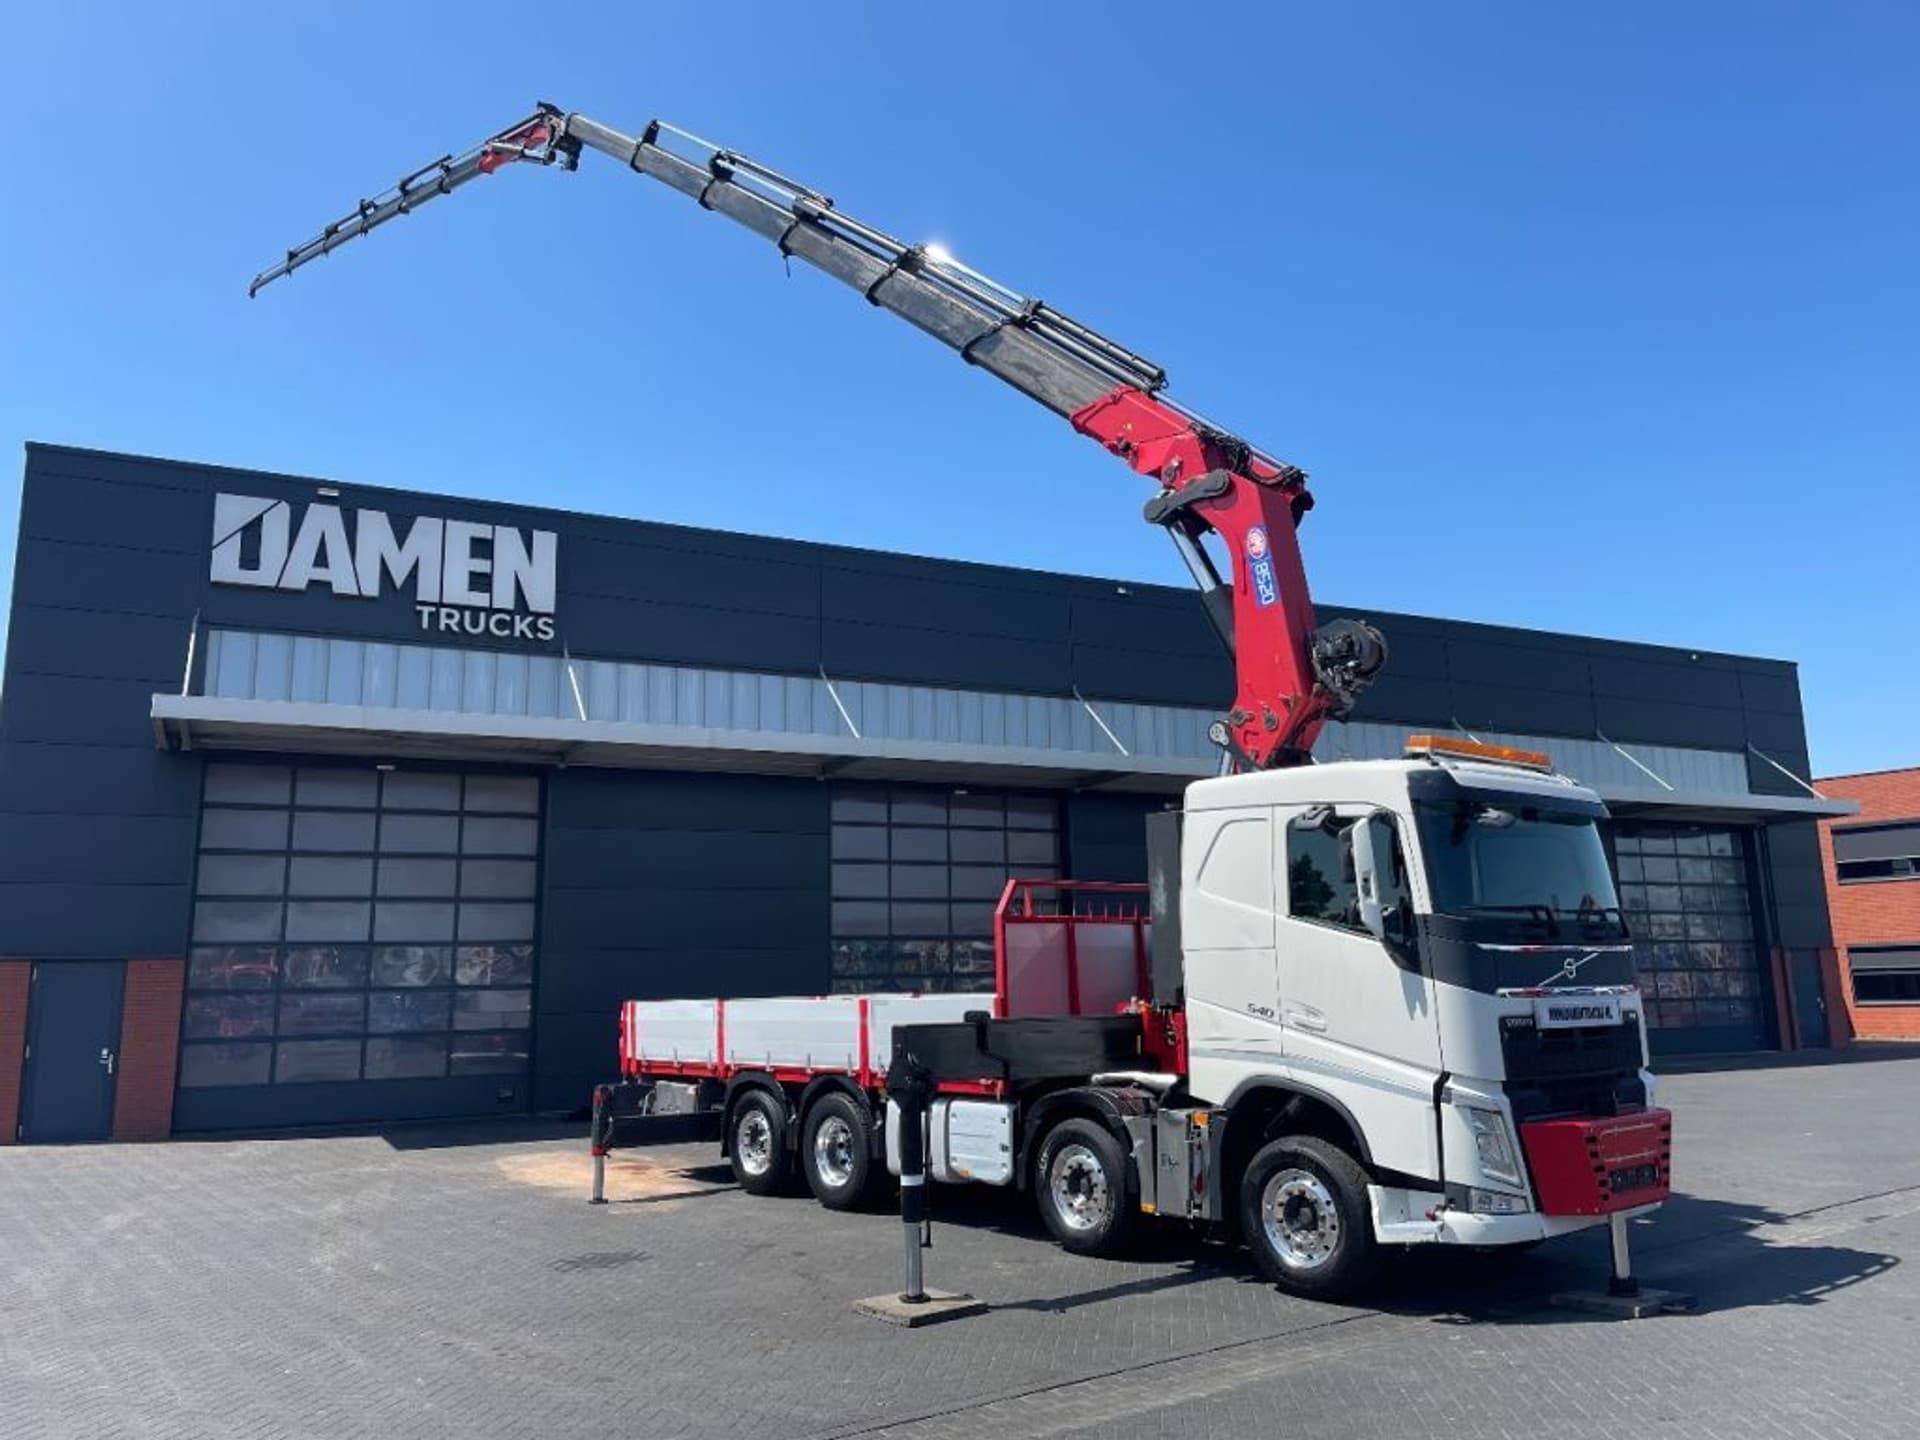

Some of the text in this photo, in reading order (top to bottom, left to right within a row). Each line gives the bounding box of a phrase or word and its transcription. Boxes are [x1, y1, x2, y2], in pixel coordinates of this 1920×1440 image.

[210, 494, 557, 613] DAMEN
[1255, 562, 1274, 604] 8520
[416, 605, 555, 640] TRUCKS
